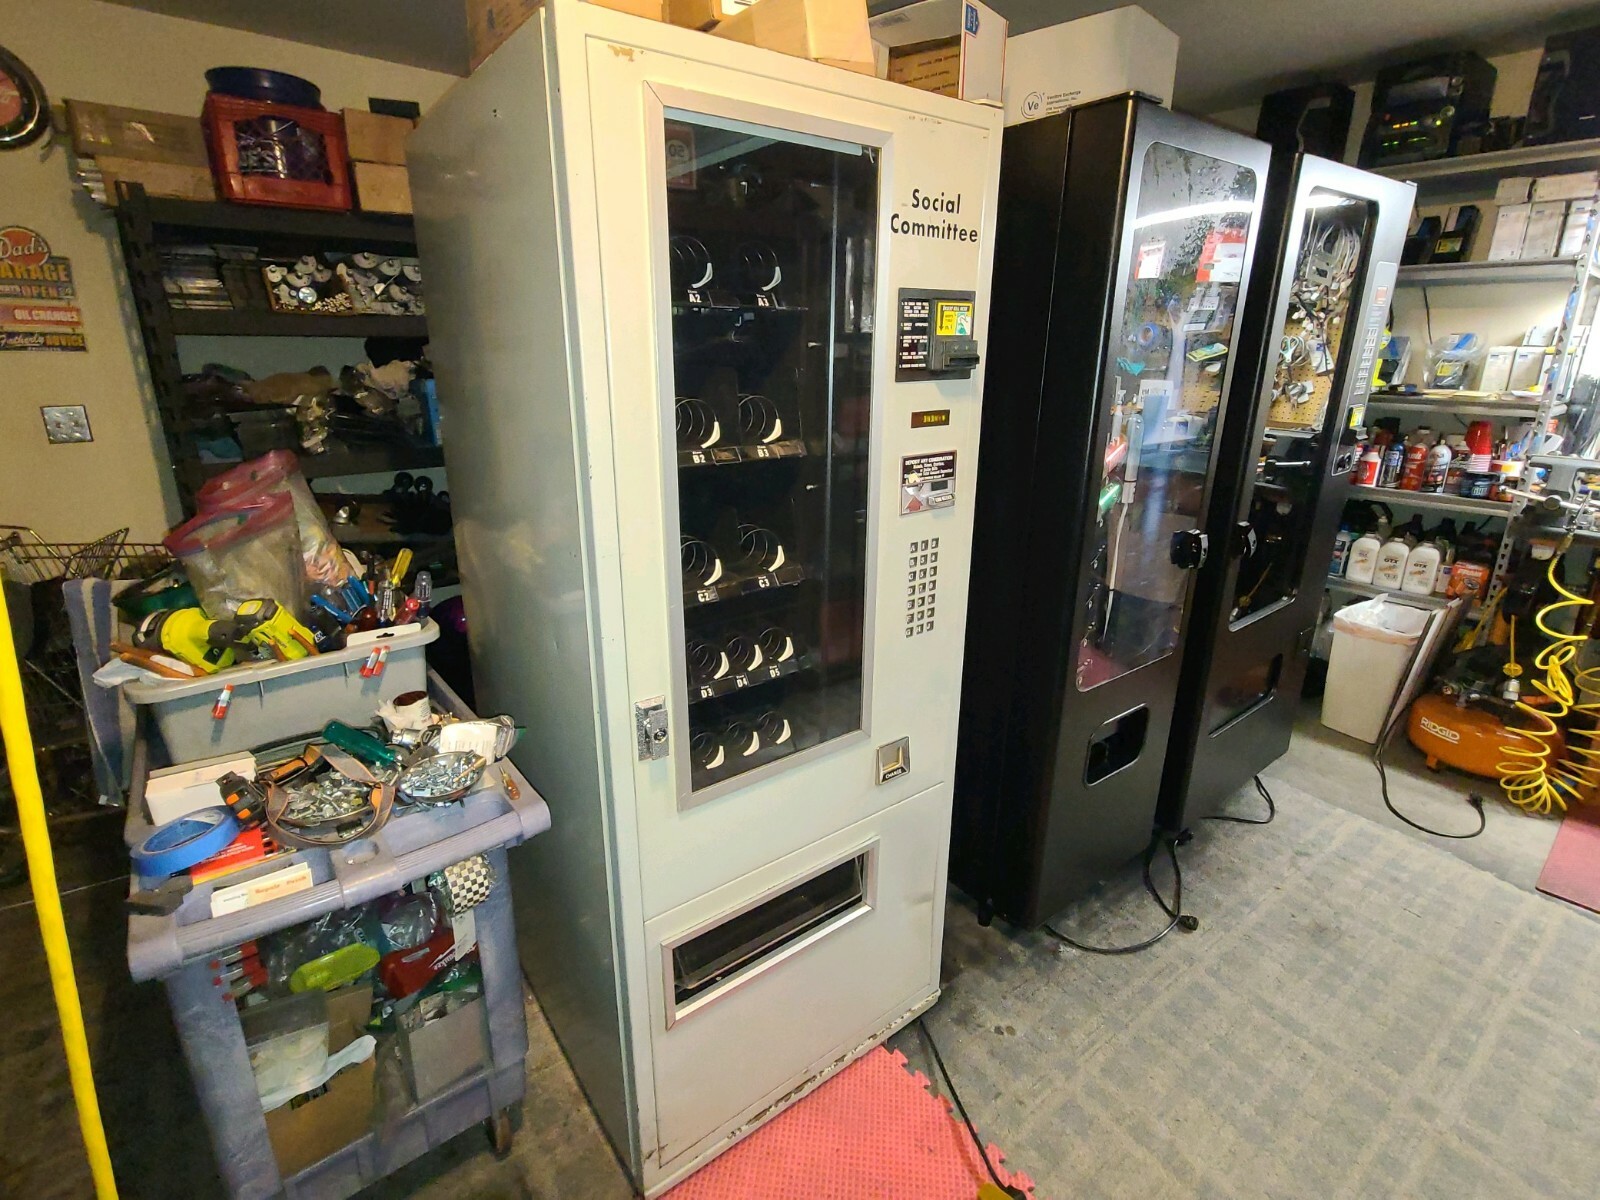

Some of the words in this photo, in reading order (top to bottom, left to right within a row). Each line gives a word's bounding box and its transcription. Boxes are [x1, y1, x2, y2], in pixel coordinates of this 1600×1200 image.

[1027, 100, 1039, 111] Ve
[912, 188, 960, 214] Social
[890, 213, 978, 243] Committee
[0, 236, 48, 259] Dad's
[21, 284, 58, 298] OPEN
[689, 294, 702, 302] A2
[758, 297, 770, 306] A3
[14, 309, 31, 320] OIL
[32, 310, 78, 322] CHANGES
[757, 448, 770, 457] B3
[692, 453, 706, 463] B2
[758, 578, 770, 588] C3
[698, 593, 710, 602] C2
[770, 669, 780, 678] D5
[736, 678, 748, 687] D4
[700, 688, 713, 698] D3
[1421, 716, 1460, 741] RIDGID
[885, 768, 902, 779] CHANGE
